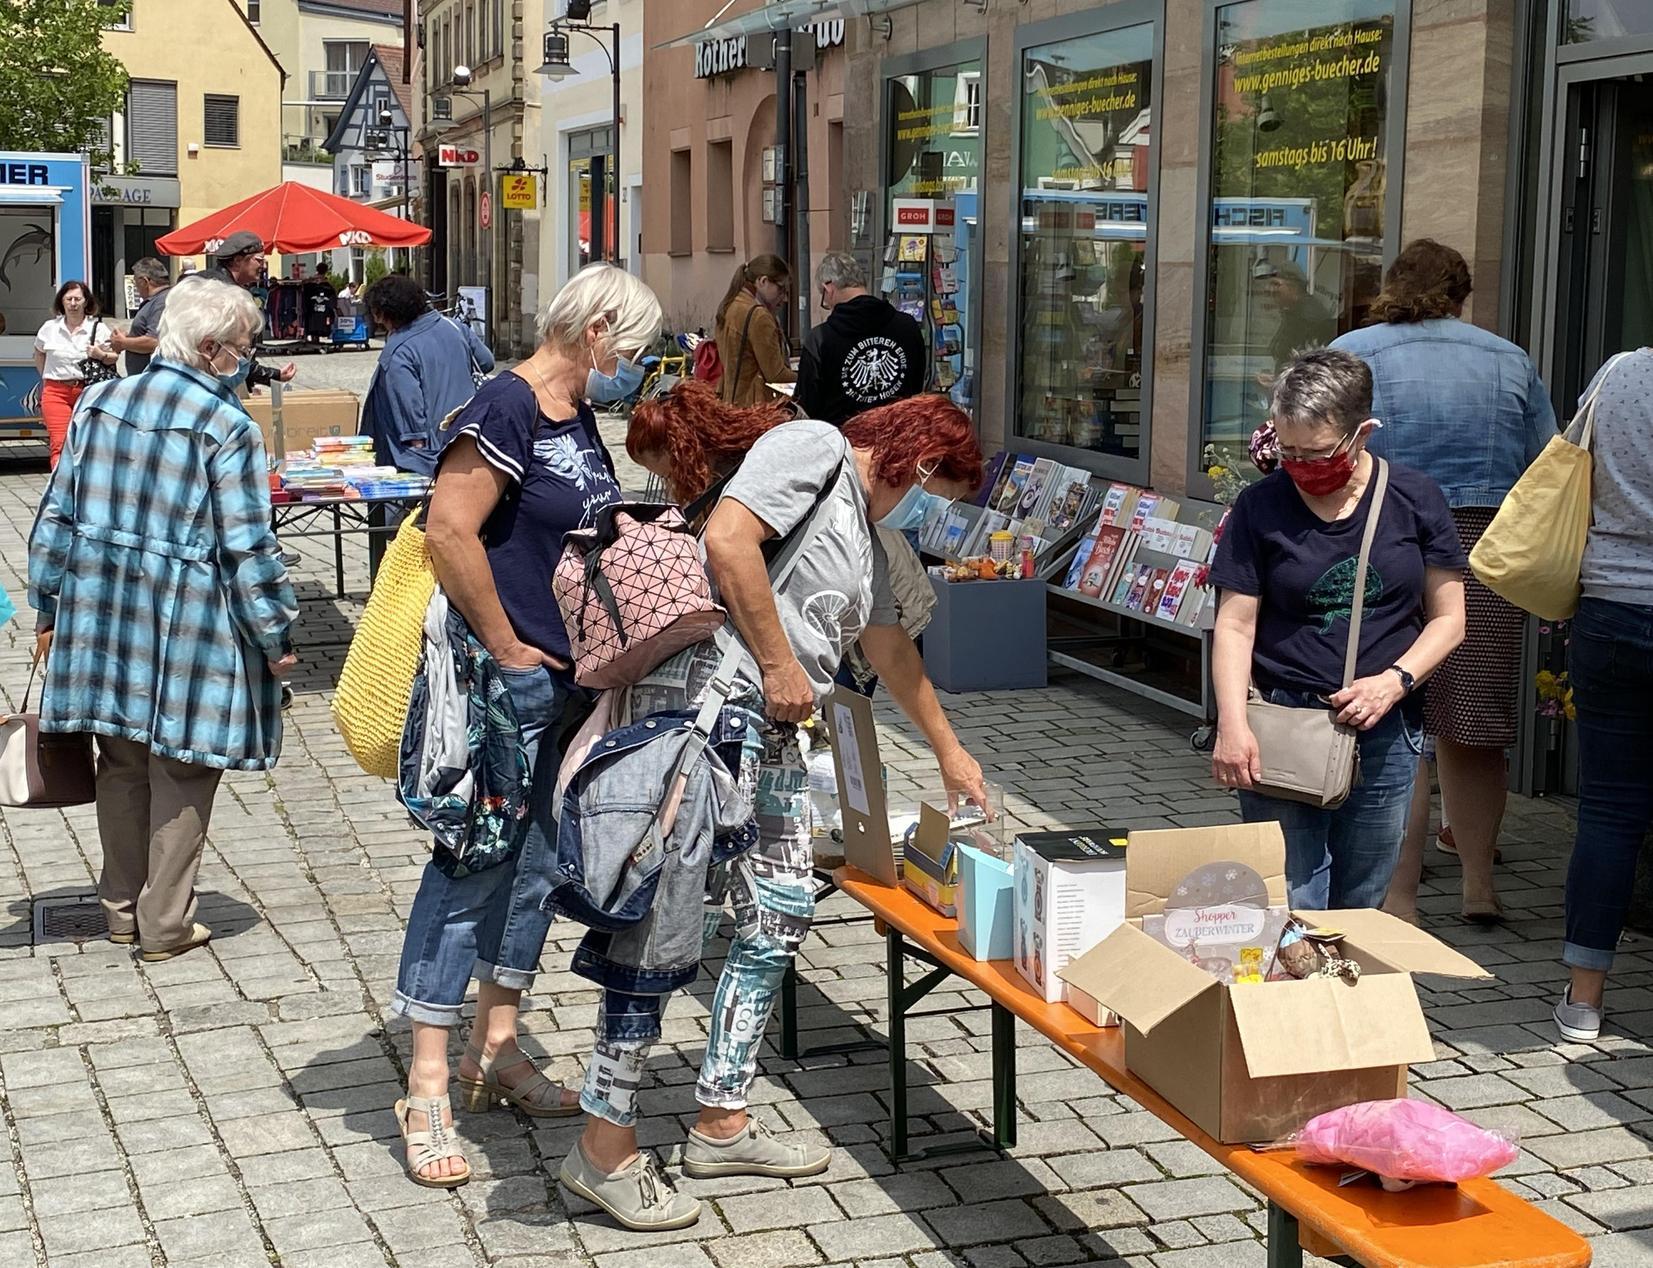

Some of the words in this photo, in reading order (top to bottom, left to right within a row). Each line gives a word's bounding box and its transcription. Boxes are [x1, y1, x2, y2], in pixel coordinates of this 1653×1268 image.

[1235, 42, 1309, 64] Internetbestellungen
[1309, 36, 1333, 52] direkt
[1333, 33, 1353, 48] nach
[1353, 29, 1382, 44] Hause:
[694, 35, 746, 79] Rother
[1233, 51, 1380, 93] www.genniges-buecher.de
[441, 149, 479, 163] NKD
[1256, 146, 1308, 169] samstags
[1310, 141, 1327, 162] bis
[1331, 140, 1346, 161] 16
[507, 193, 531, 201] LOTTO
[900, 212, 926, 220] GROH
[338, 230, 373, 246] NKD
[844, 347, 859, 365] ZUM
[857, 336, 897, 350] BITTEREN
[895, 346, 907, 370] ENDE
[879, 380, 903, 400] HOSEN
[1194, 907, 1237, 925] Shopper
[1175, 923, 1255, 939] ZAUBERWINTER
